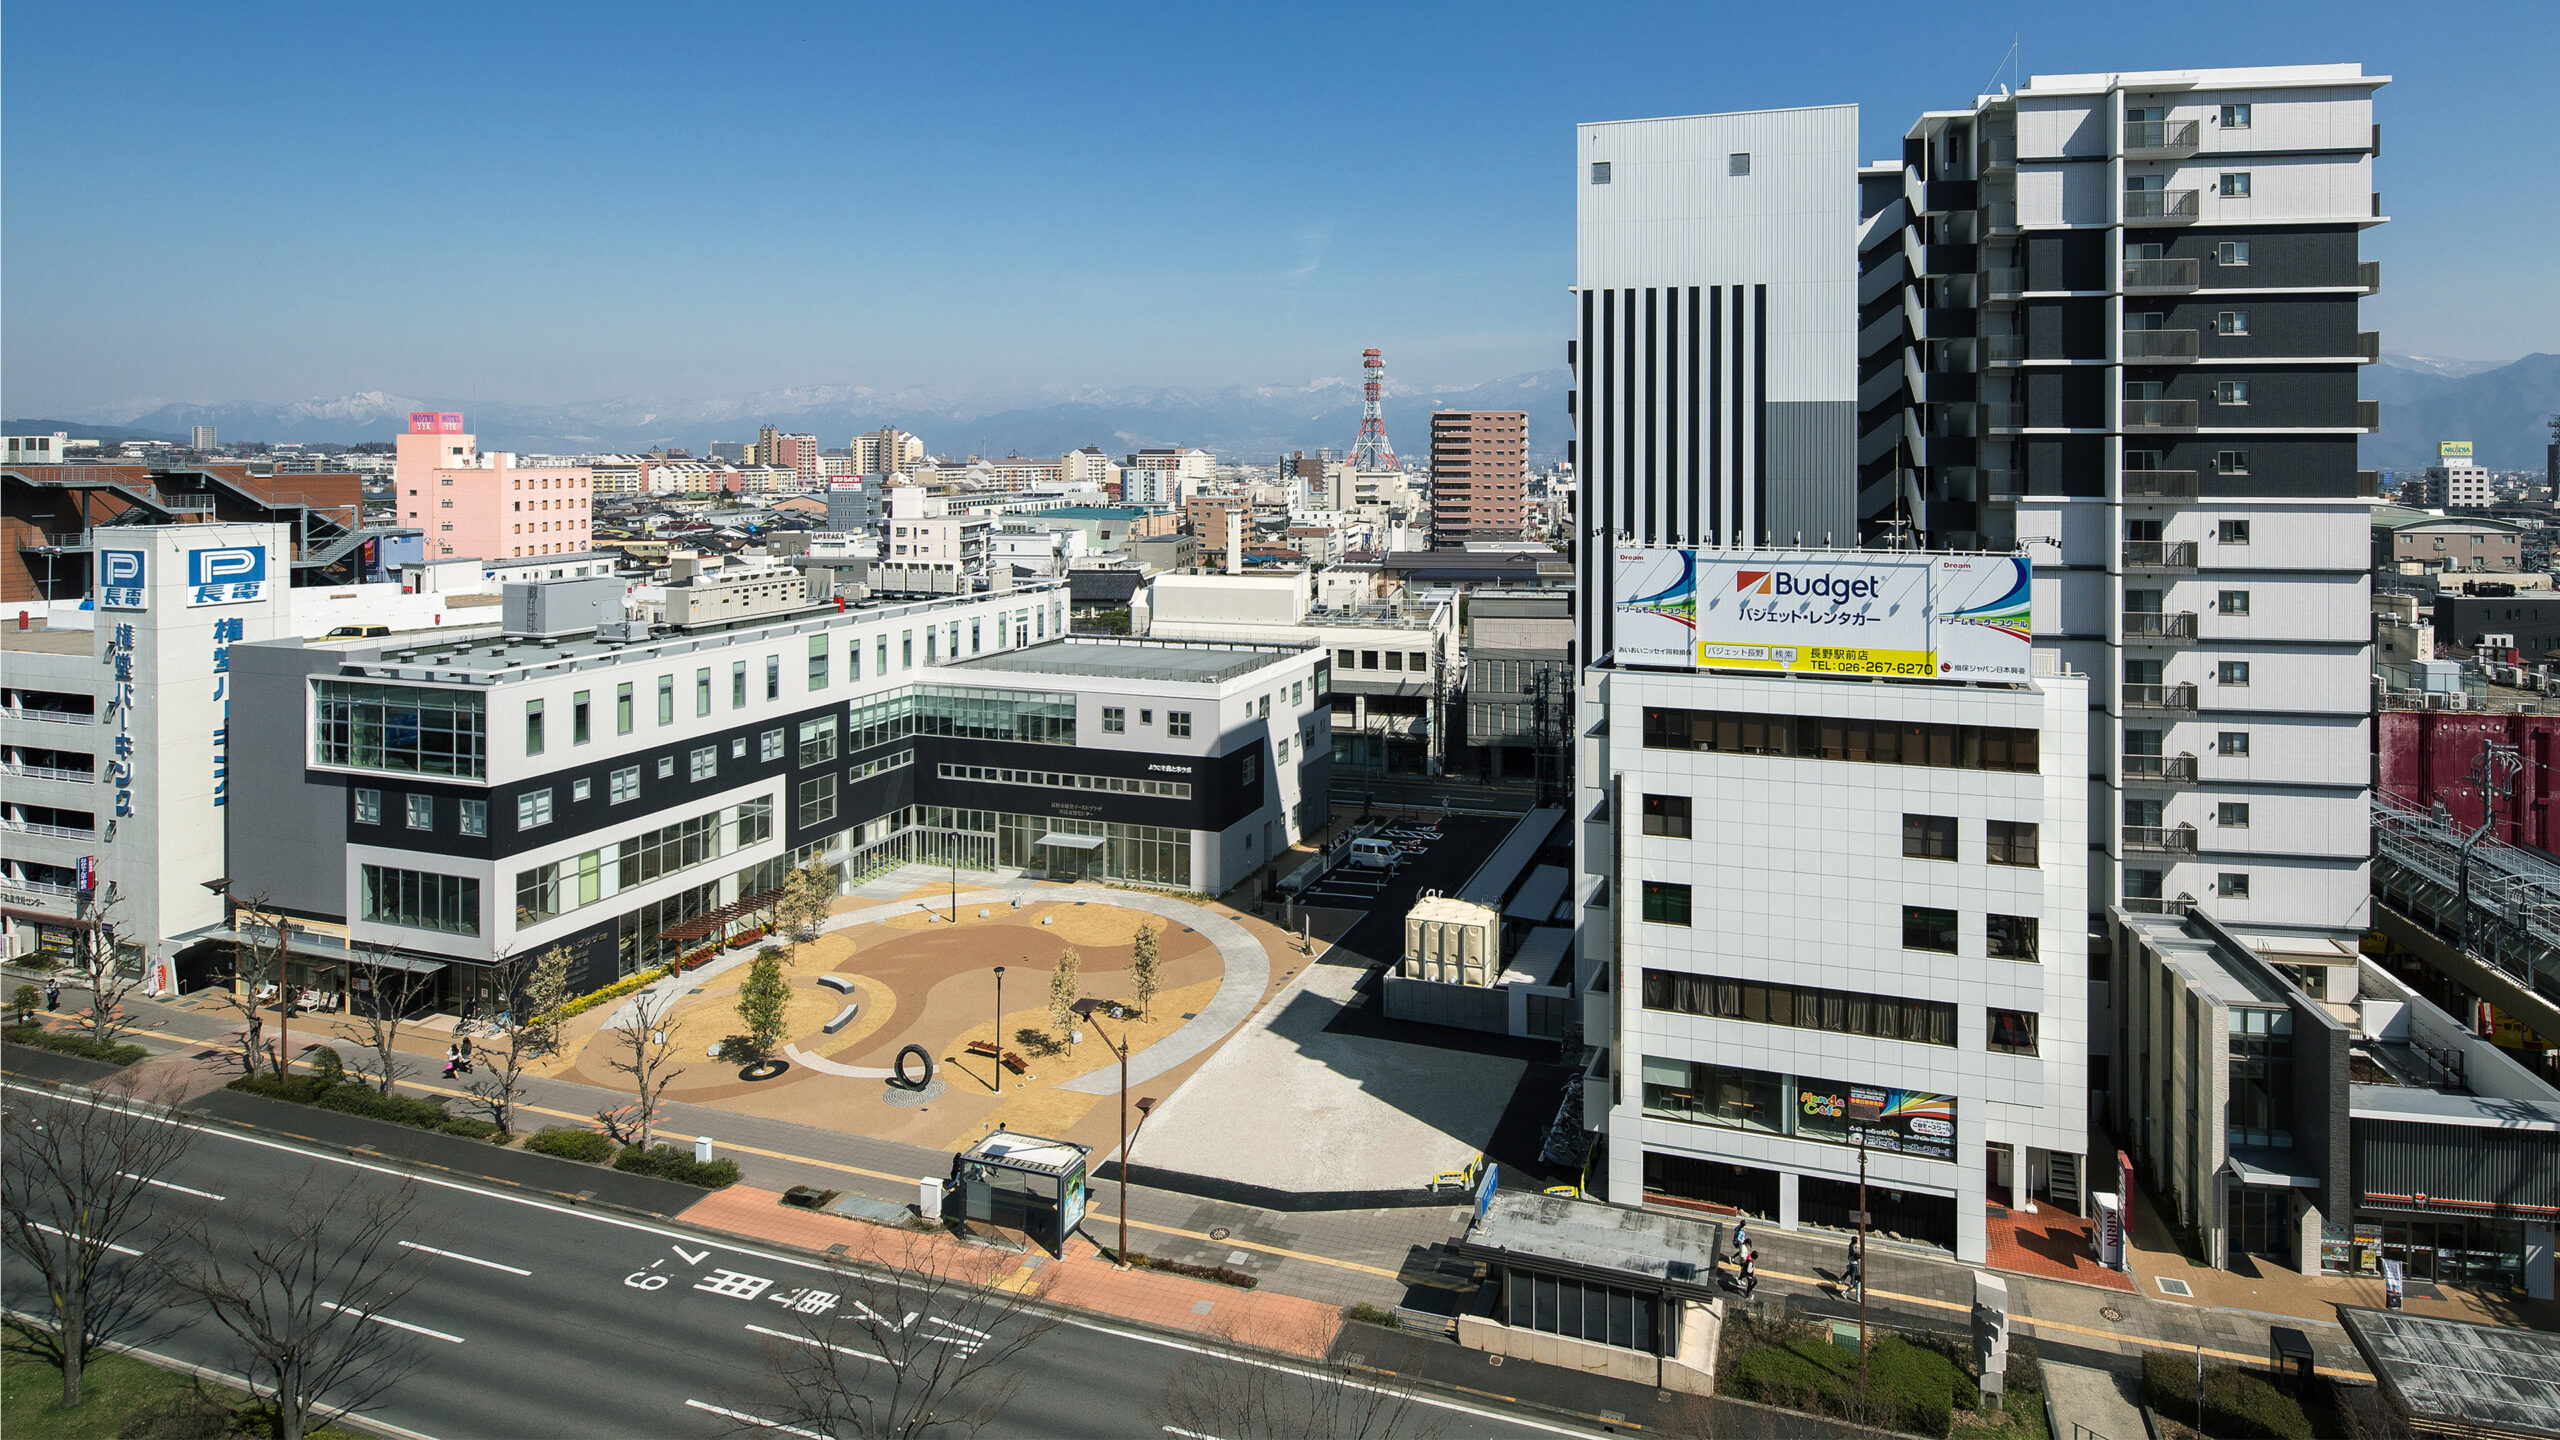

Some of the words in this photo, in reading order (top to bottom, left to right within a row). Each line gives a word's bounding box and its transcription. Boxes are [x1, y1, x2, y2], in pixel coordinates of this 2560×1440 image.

[417, 422, 431, 431] YYK
[194, 582, 260, 604] 長電
[1776, 572, 1880, 605] Budget
[104, 587, 142, 606] 長電
[1617, 606, 1694, 616] ドリームモータースクール
[1739, 608, 1881, 626] バジェット・レンタカー
[1939, 617, 2028, 628] ドリームモータースクール
[1618, 646, 1692, 656] あいおいニッセイ同和損保
[1708, 646, 1764, 658] バジェット長野
[1774, 650, 1794, 660] 検索
[1810, 648, 1868, 661] 長野駅前店
[1838, 662, 1933, 675] 026-267-6270
[1954, 664, 2026, 674] 損保ジャパン日本興亜
[115, 622, 134, 818] 権堂パーキング
[1800, 1091, 1845, 1108] Honda
[1804, 1103, 1842, 1117] Cafe
[2106, 1210, 2118, 1247] KIRIN
